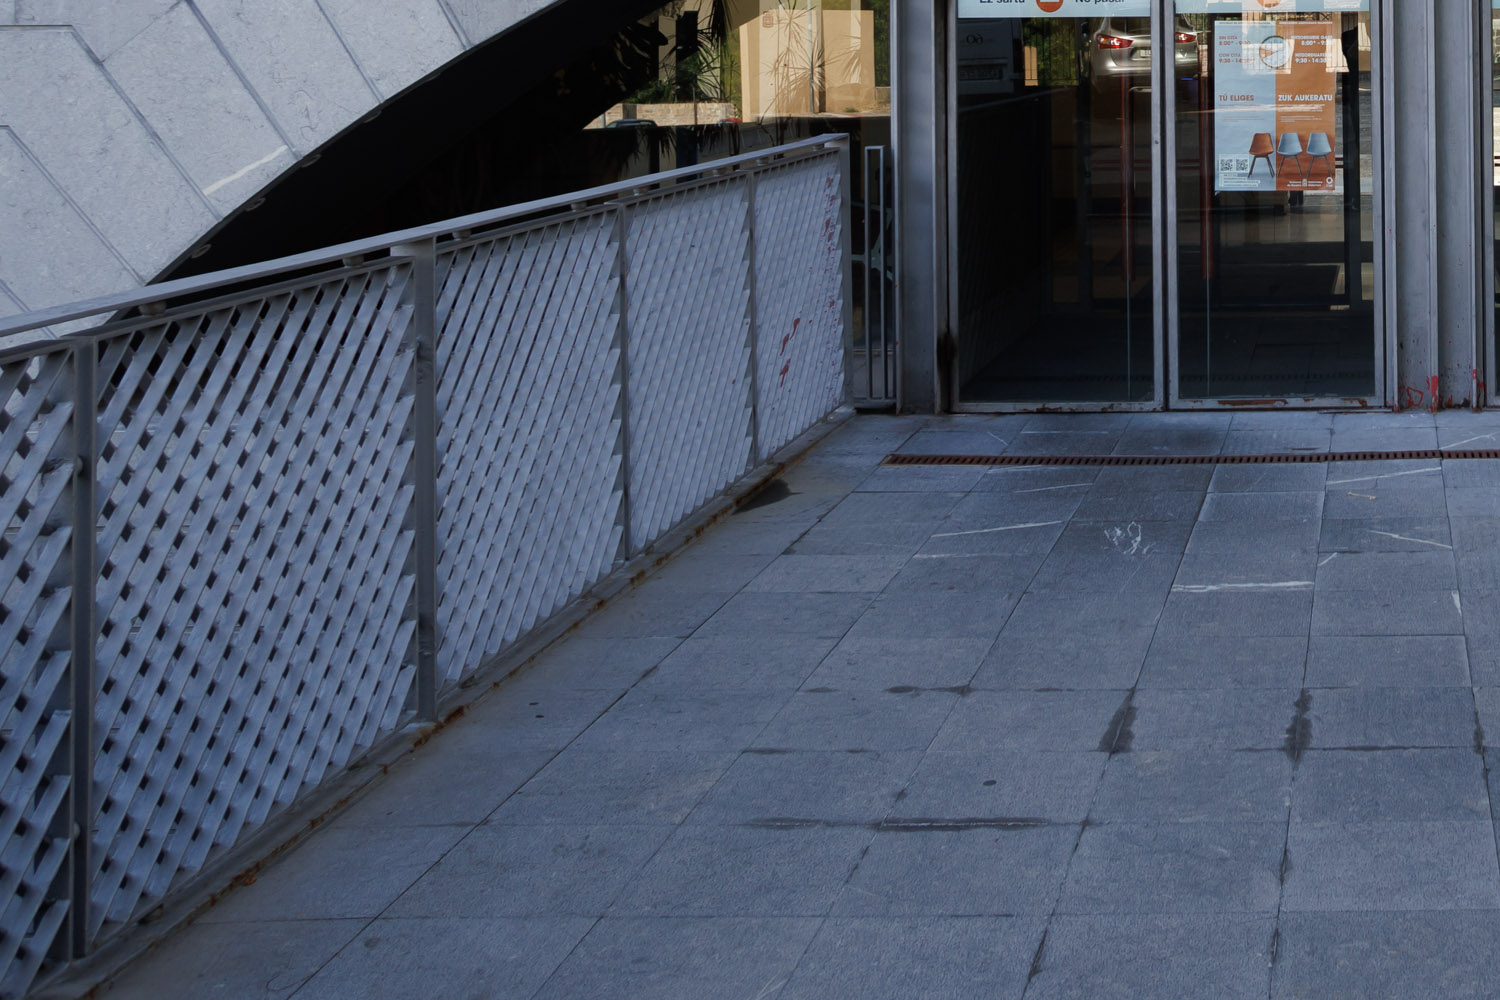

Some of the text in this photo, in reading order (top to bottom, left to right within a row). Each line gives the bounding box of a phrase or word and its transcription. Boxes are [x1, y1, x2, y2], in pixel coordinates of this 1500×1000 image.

[1218, 93, 1228, 101] TÚ
[1278, 94, 1333, 102] ZUK AUKERATU
